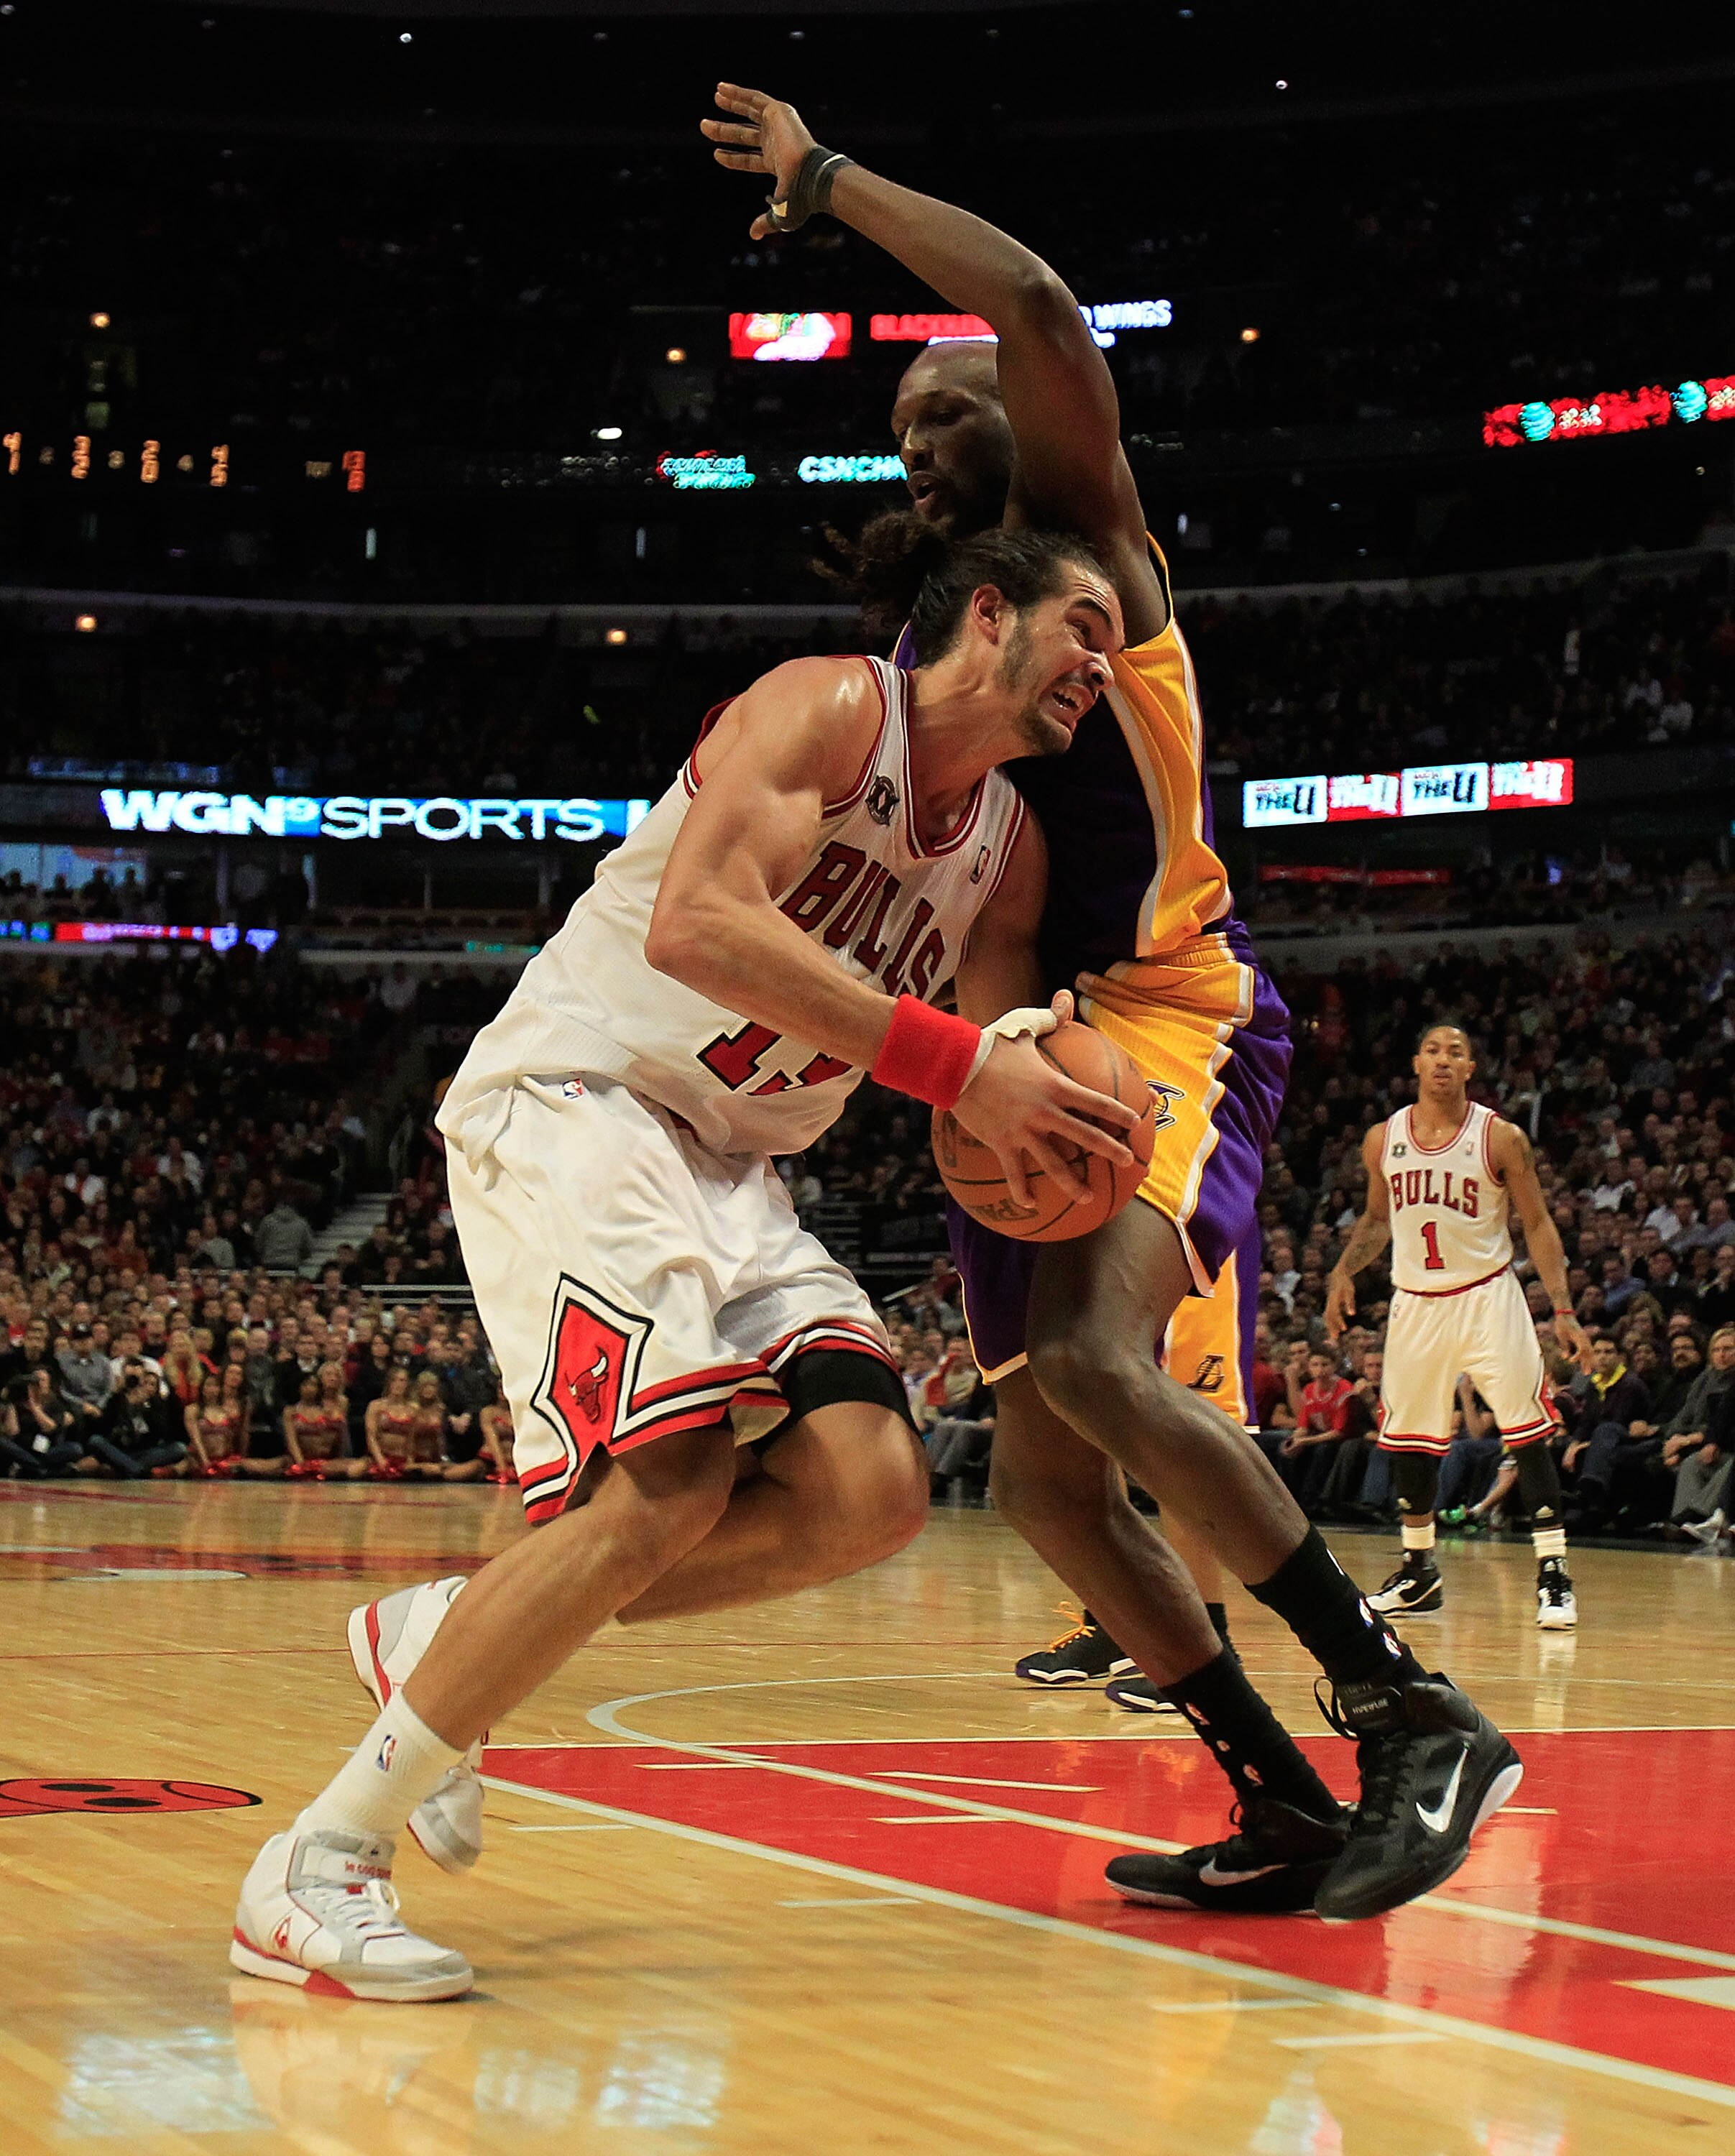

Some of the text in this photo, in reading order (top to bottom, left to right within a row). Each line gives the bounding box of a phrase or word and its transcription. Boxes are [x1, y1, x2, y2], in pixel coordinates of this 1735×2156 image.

[1092, 299, 1172, 331] WINGS
[321, 796, 605, 842] SPORTS
[777, 840, 945, 1004] BULLS
[1391, 1169, 1479, 1219] BULLS
[1421, 1221, 1445, 1270] 1
